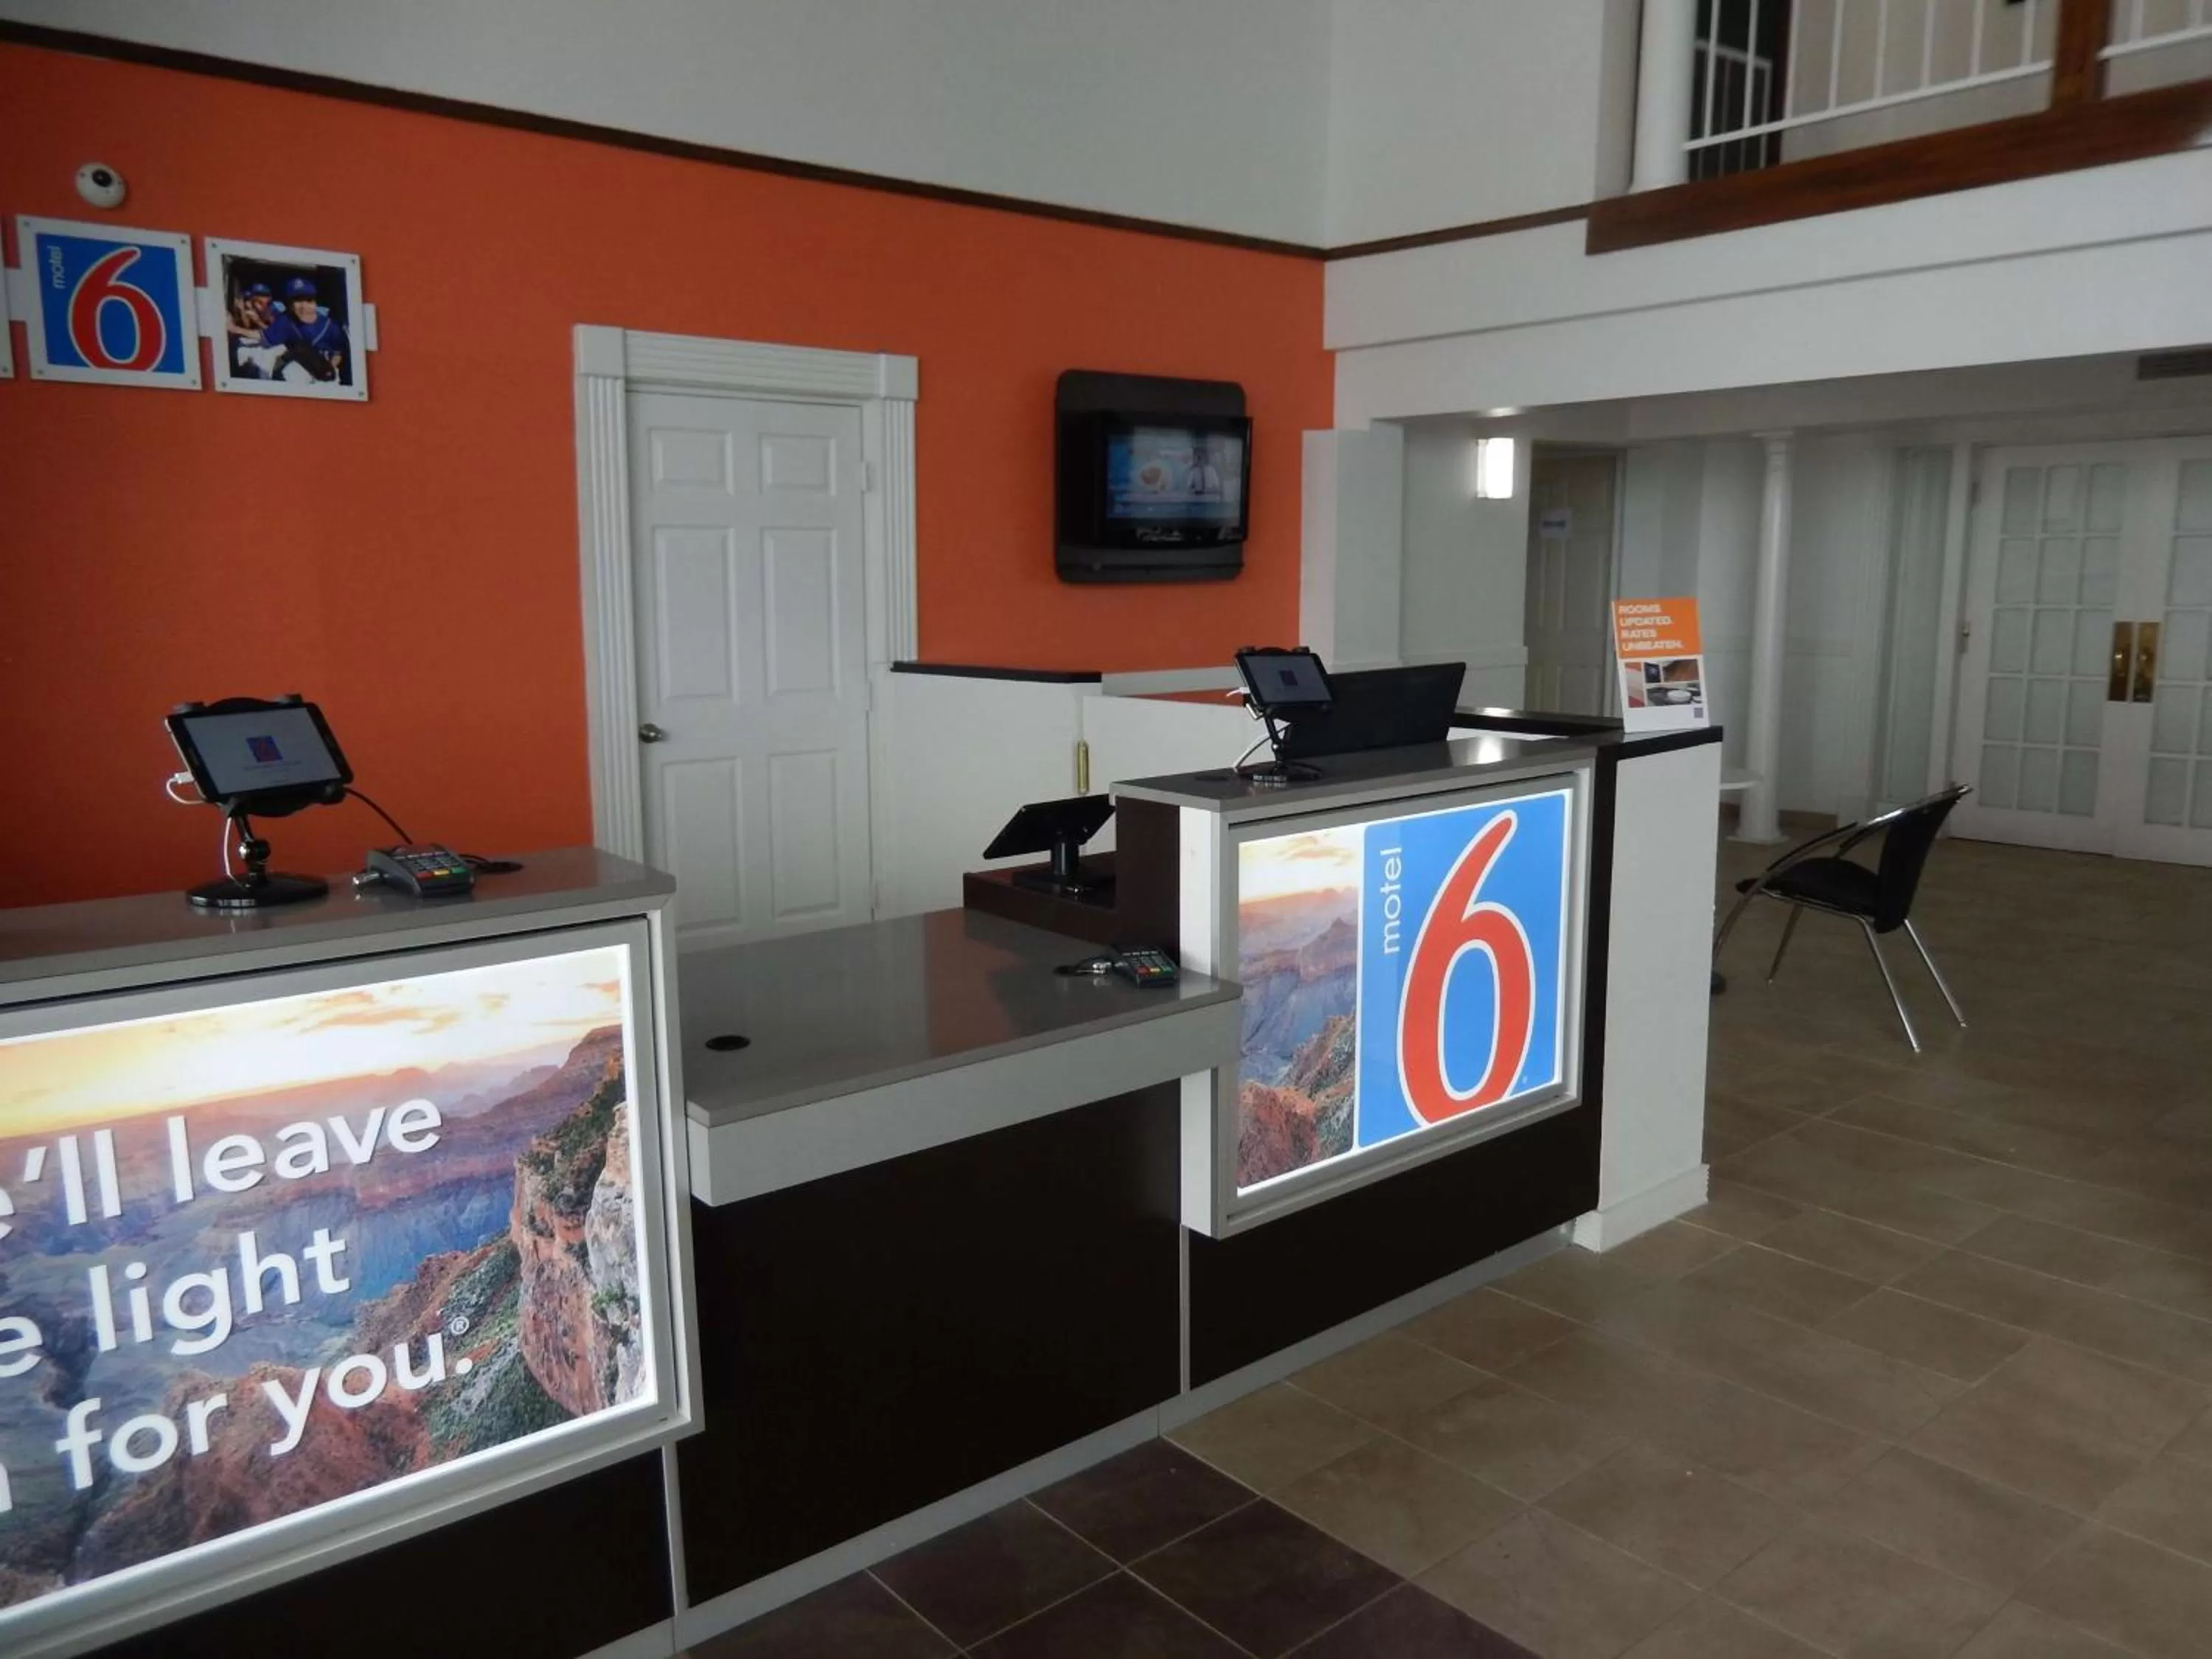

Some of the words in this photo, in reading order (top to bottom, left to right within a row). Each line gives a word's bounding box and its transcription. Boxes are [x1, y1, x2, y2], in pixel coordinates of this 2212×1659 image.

[46, 245, 66, 290] motel
[68, 246, 167, 371] 6
[1380, 846, 1402, 955] motel
[1397, 810, 1535, 1129] 6
[167, 1098, 442, 1203] leave
[89, 1228, 351, 1356] light
[56, 1393, 228, 1490] for
